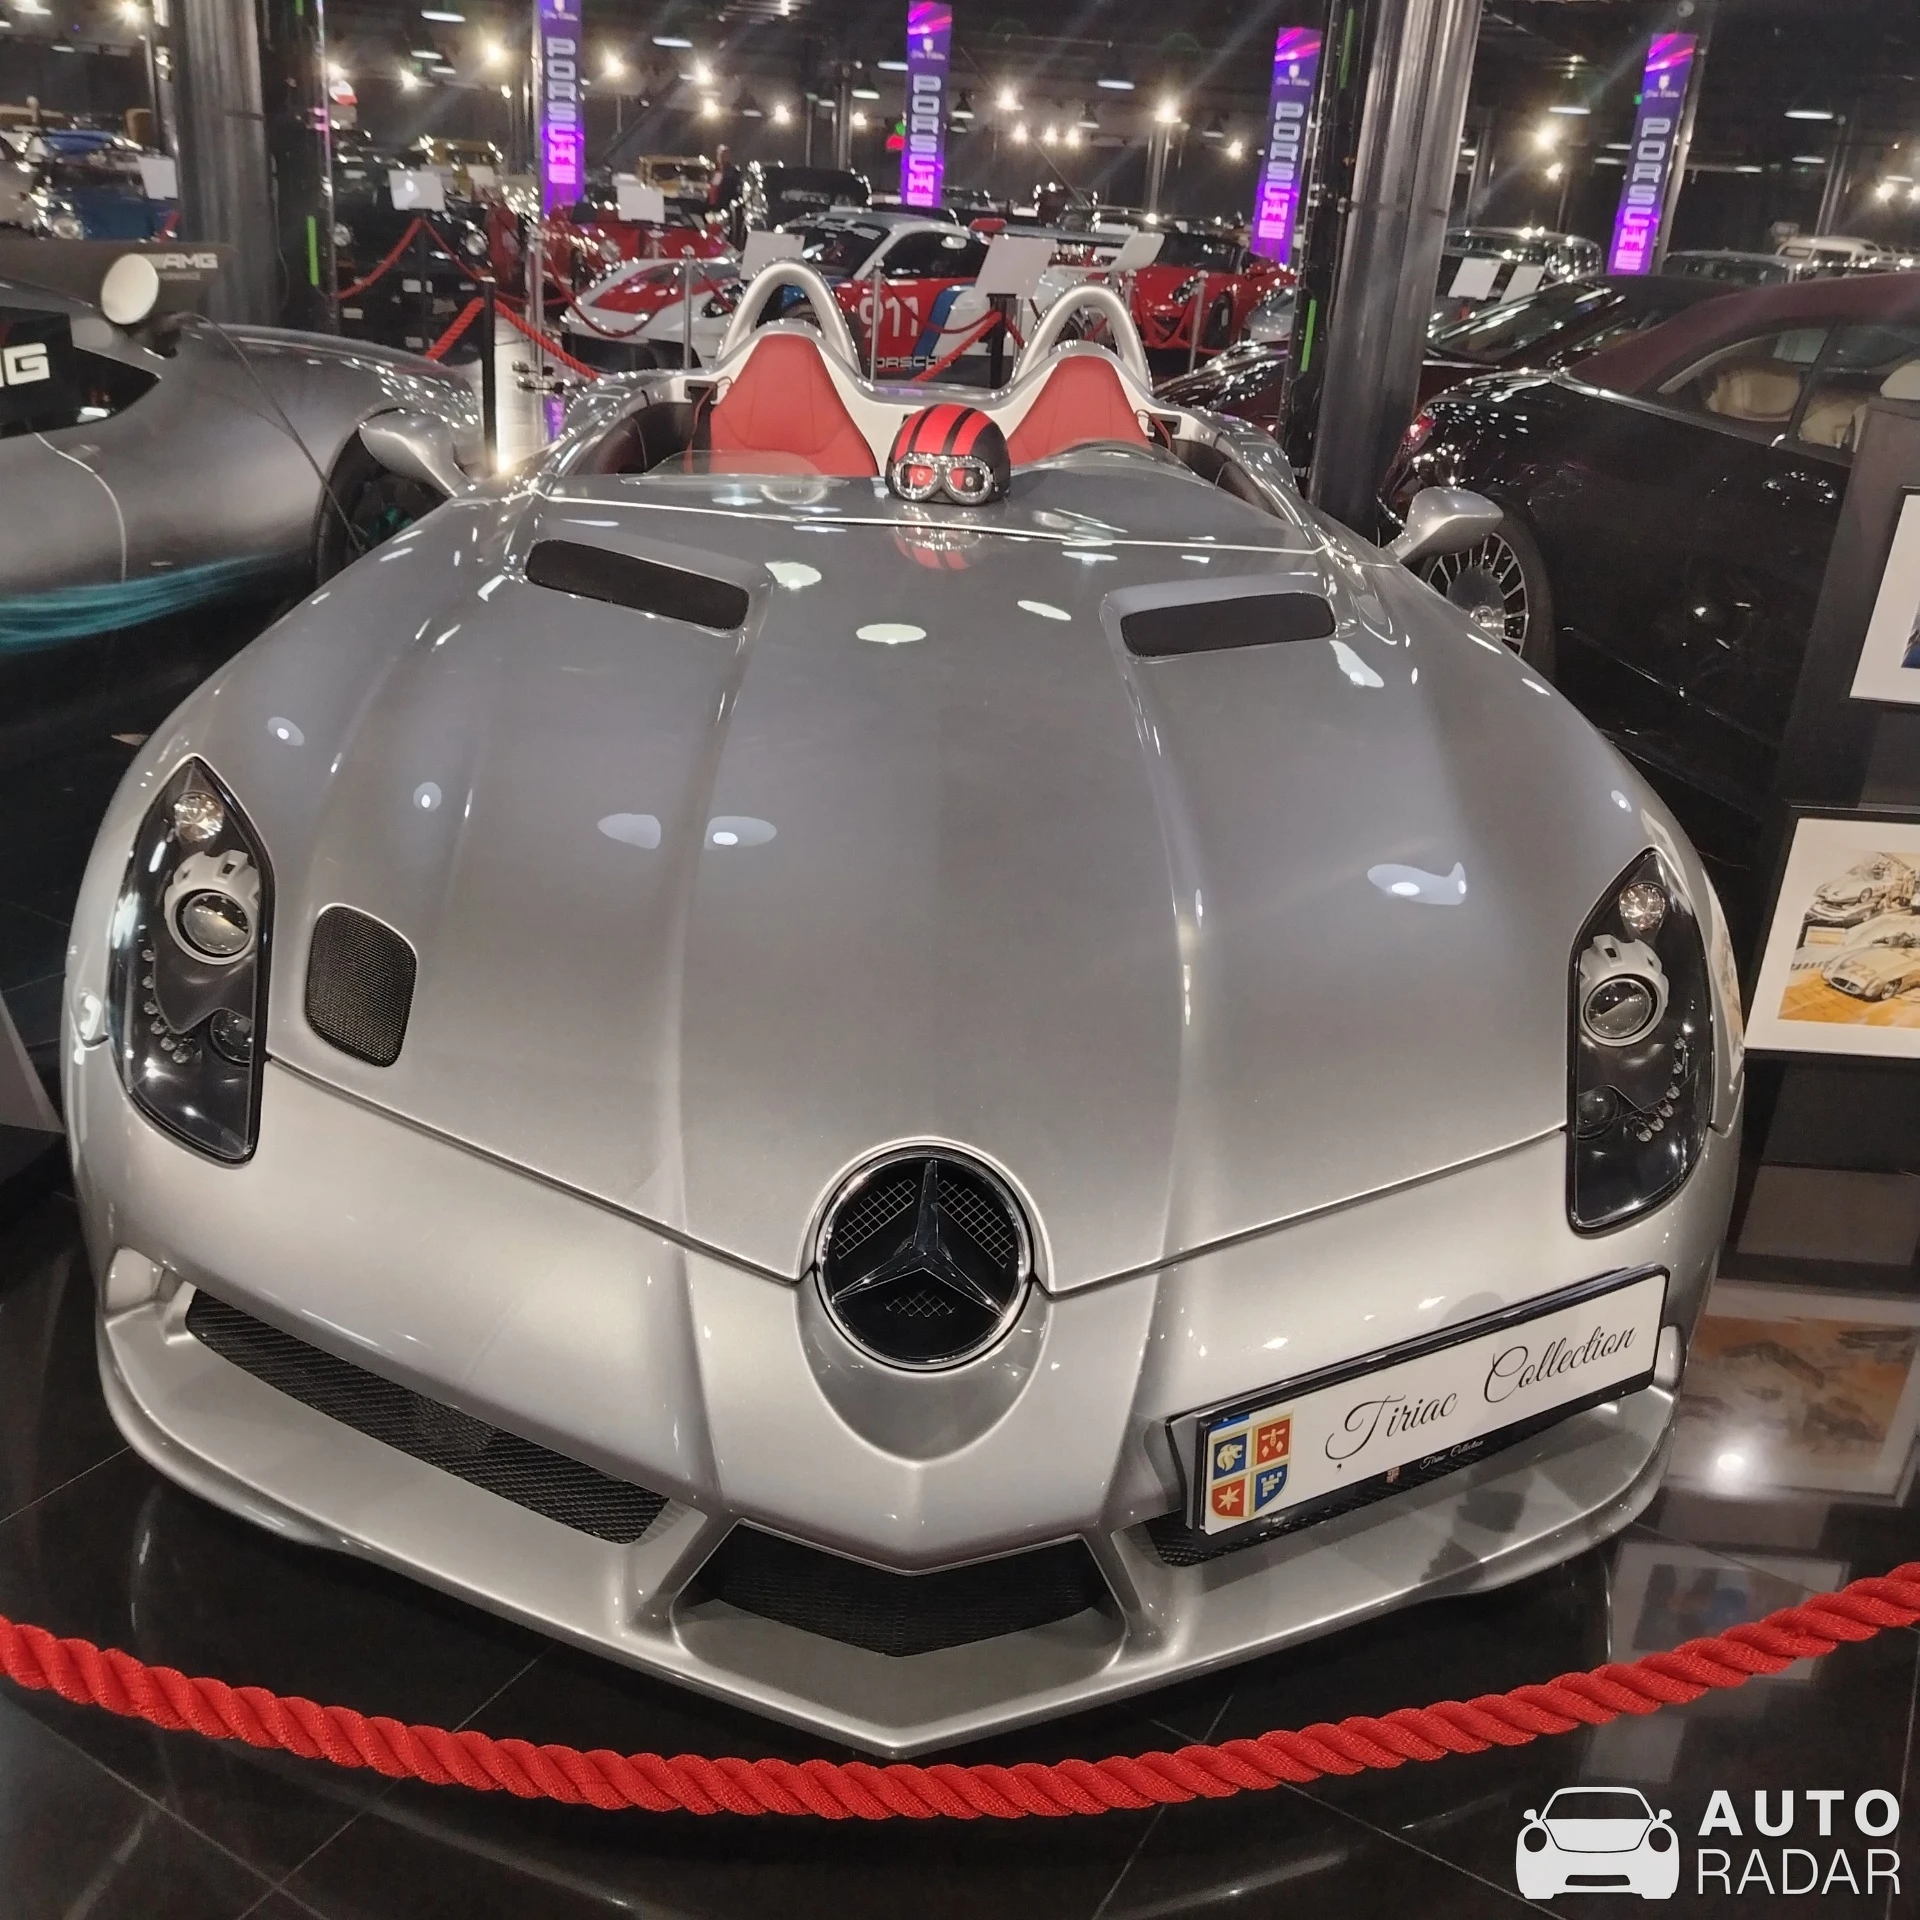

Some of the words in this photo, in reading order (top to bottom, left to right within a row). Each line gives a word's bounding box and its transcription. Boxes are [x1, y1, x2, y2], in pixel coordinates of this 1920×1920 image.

[547, 36, 576, 184] PORSCHE
[907, 75, 942, 206] PORSCHE
[1258, 102, 1304, 240] PORSCHE
[1615, 117, 1671, 271] PORSCHE
[163, 253, 218, 269] AMG
[860, 296, 919, 338] 911
[1484, 1326, 1637, 1404] Collection
